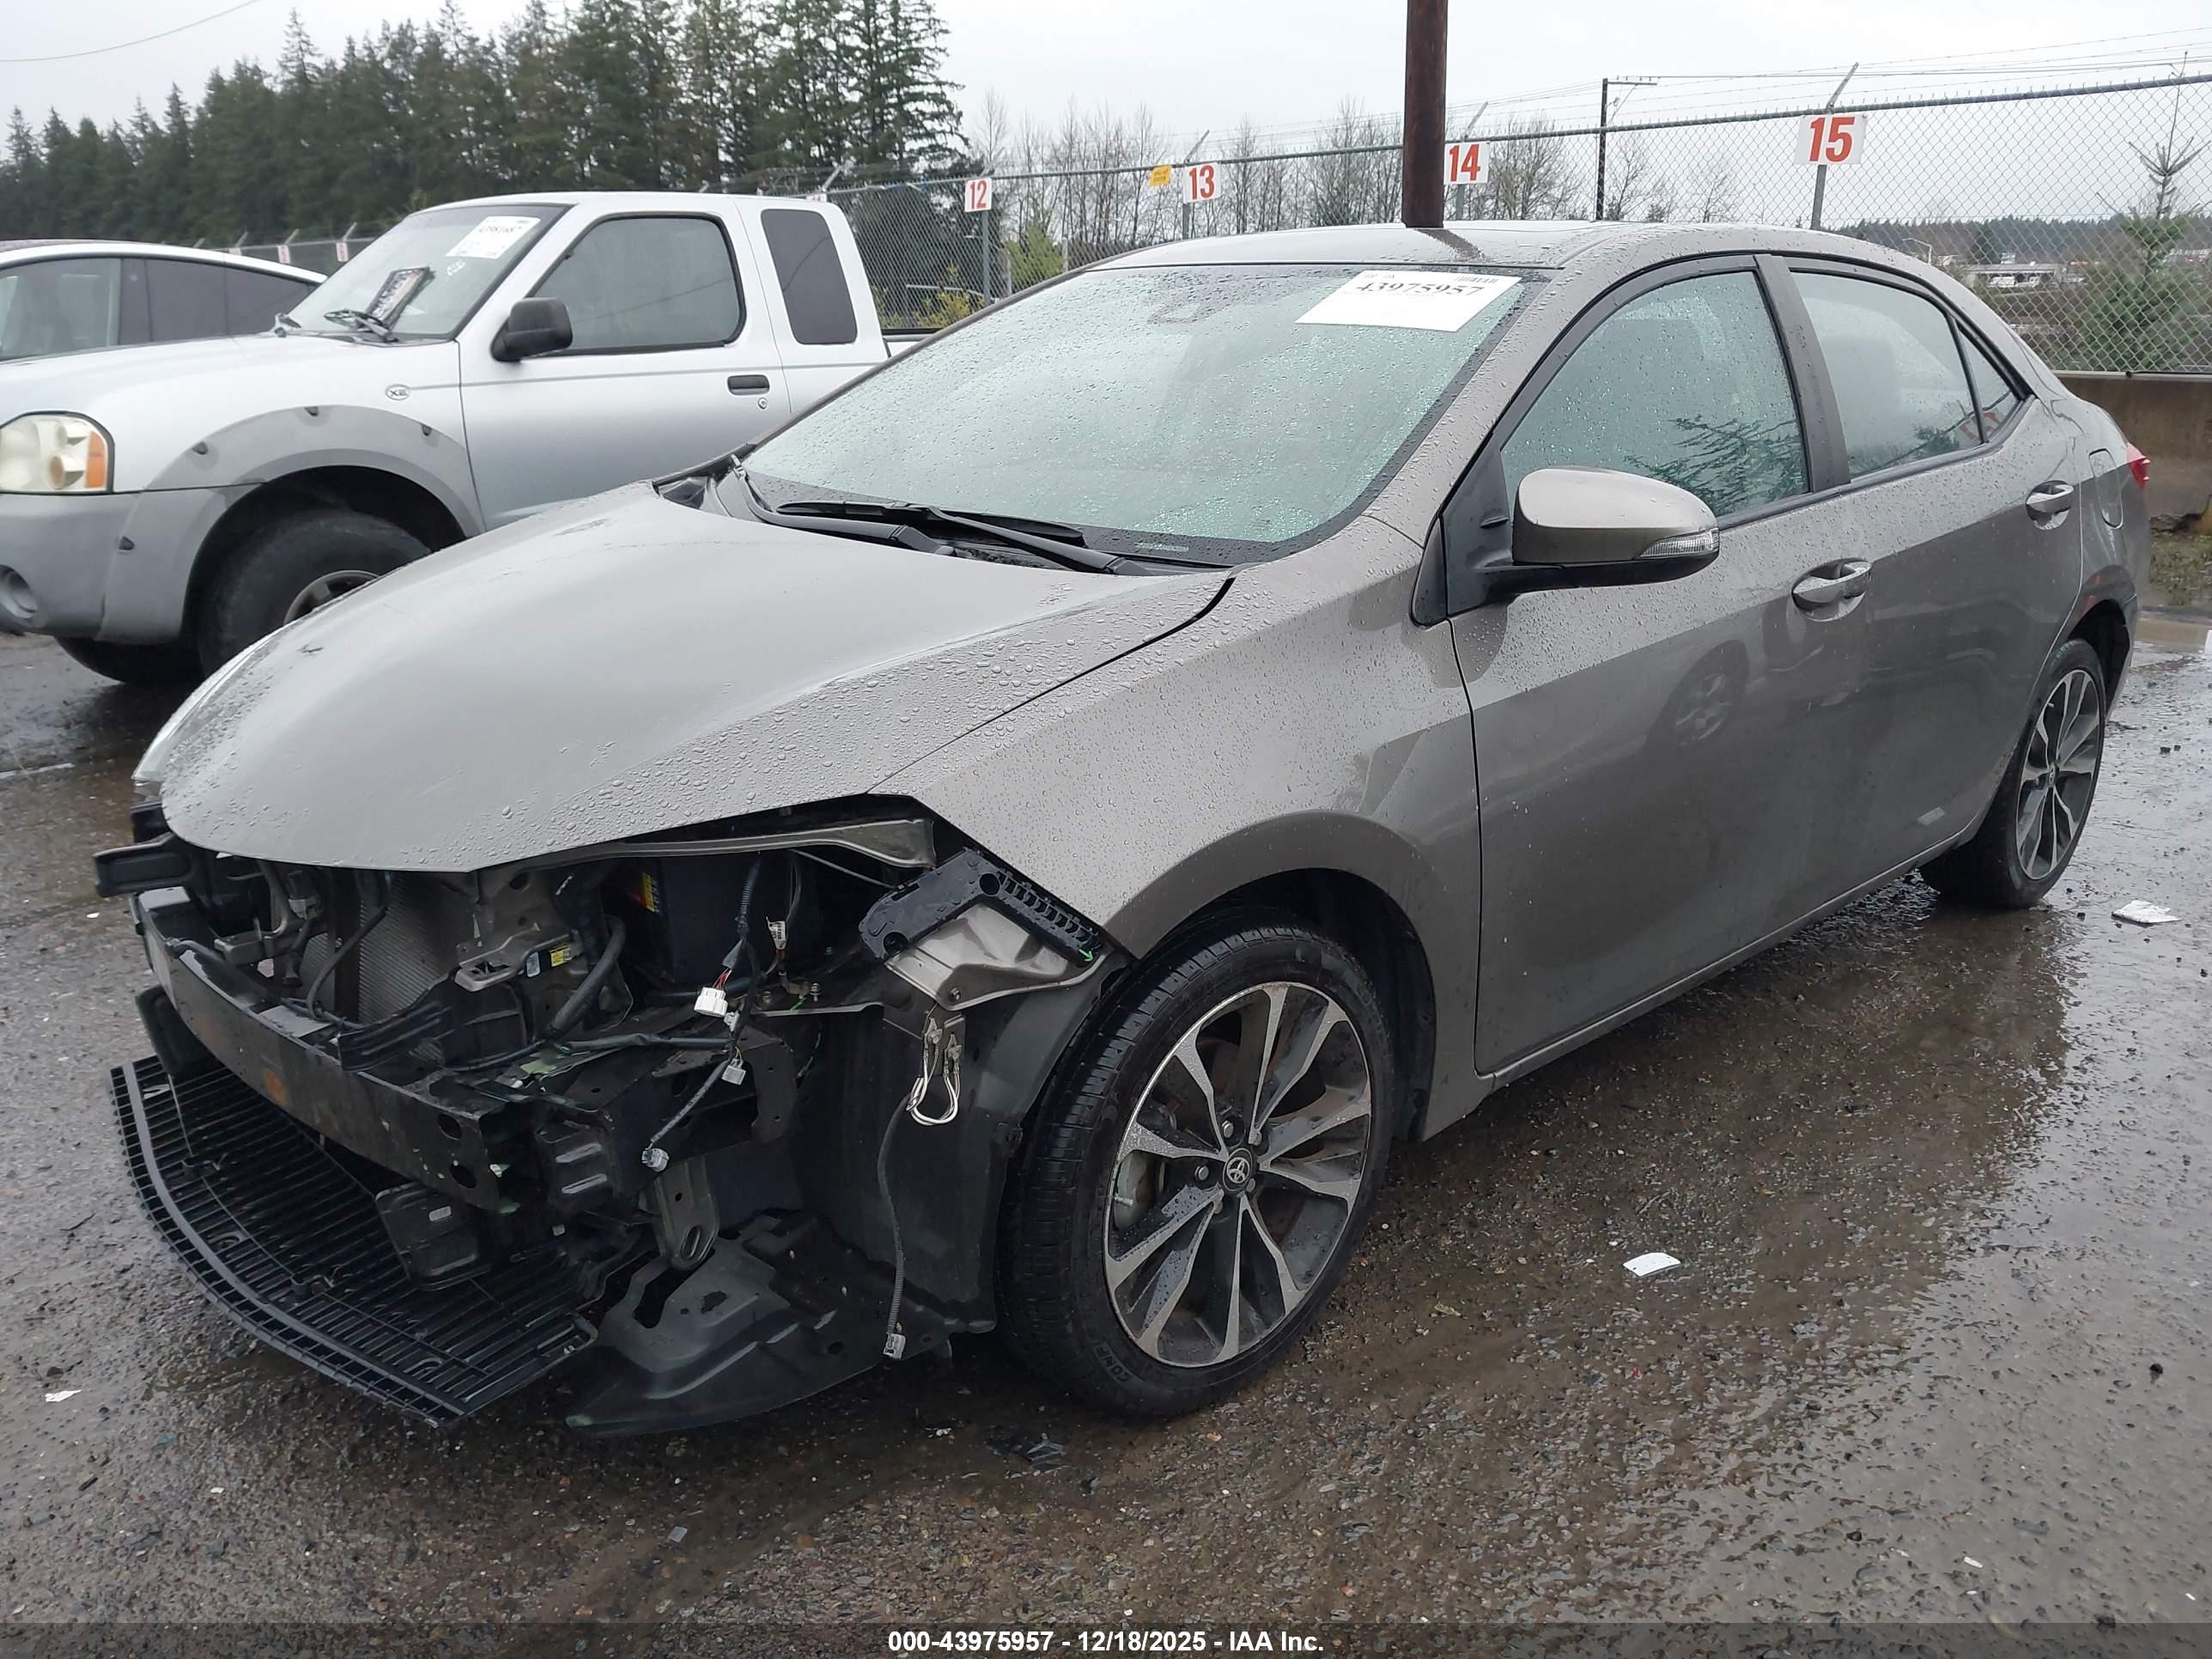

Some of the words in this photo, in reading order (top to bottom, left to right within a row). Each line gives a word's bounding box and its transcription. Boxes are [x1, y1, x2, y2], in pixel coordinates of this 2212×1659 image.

[1809, 116, 1856, 163] 15
[1449, 143, 1481, 182] 14
[970, 180, 988, 210] 12
[1189, 165, 1215, 200] 13
[1357, 282, 1485, 295] 43975957
